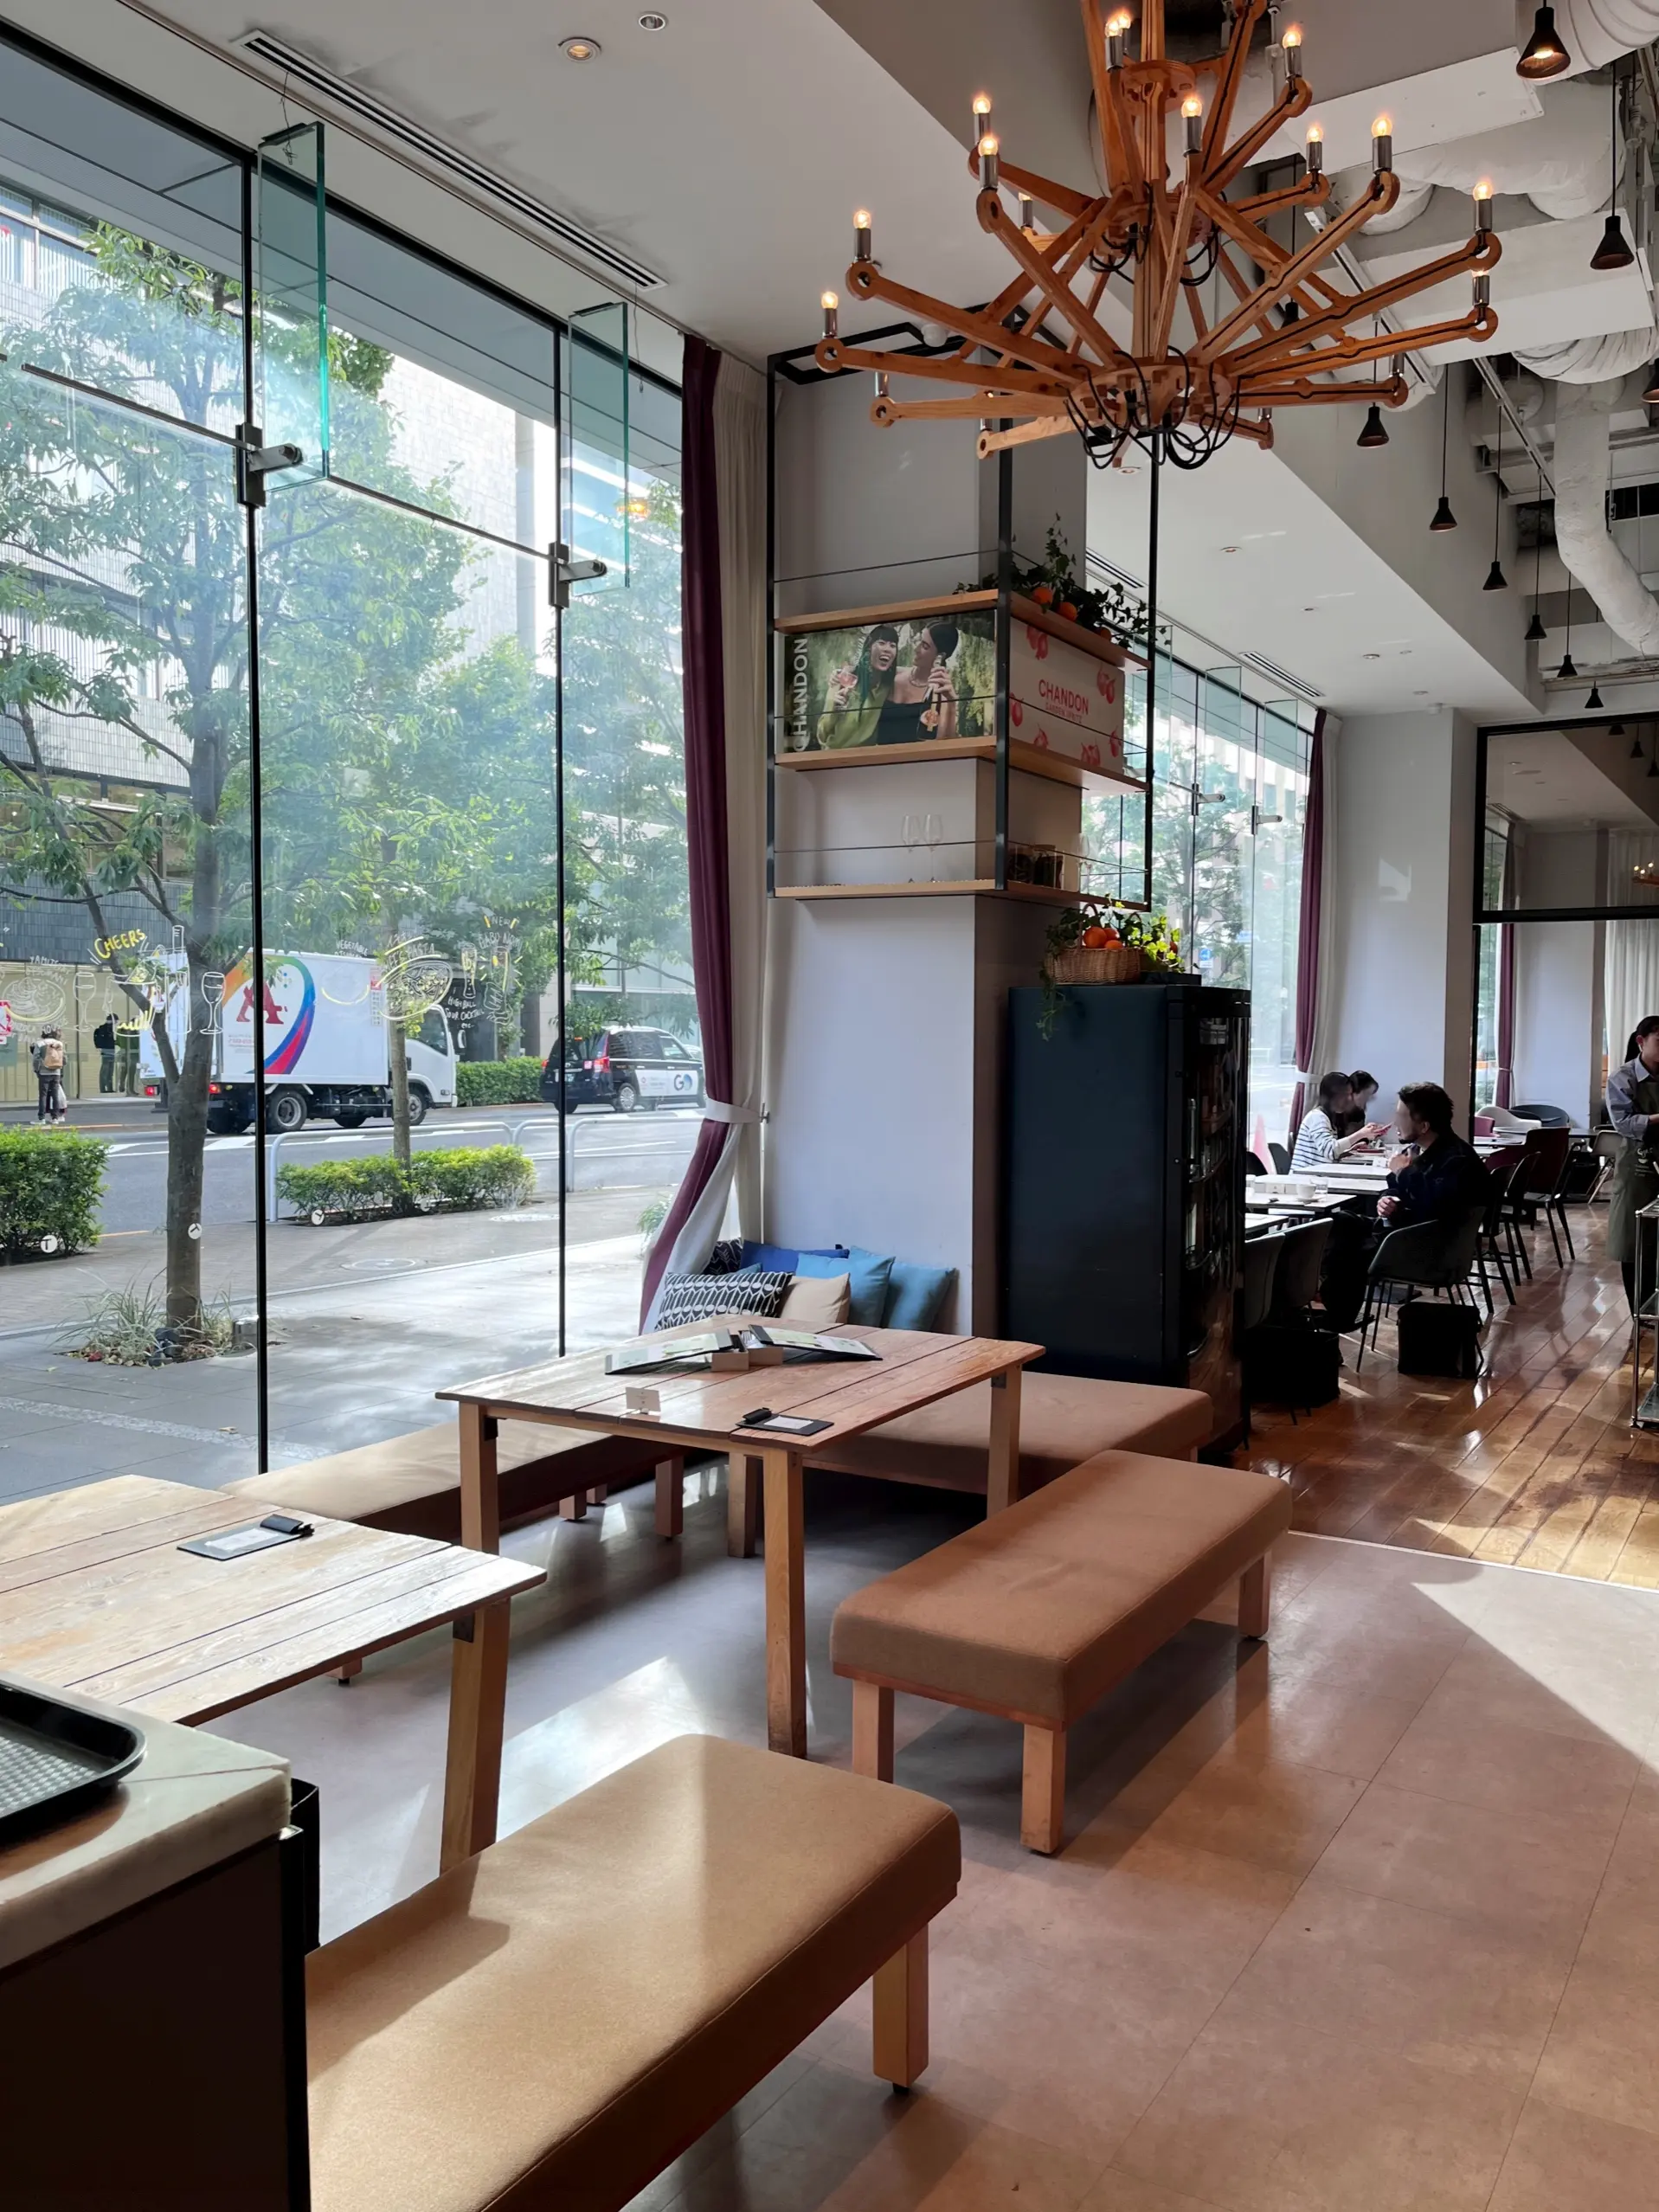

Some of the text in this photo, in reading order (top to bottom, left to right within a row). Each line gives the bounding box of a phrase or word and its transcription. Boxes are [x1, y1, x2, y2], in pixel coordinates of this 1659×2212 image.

[794, 638, 808, 752] CHANDON
[1039, 679, 1089, 715] CHANDON
[94, 929, 145, 958] CHEERS
